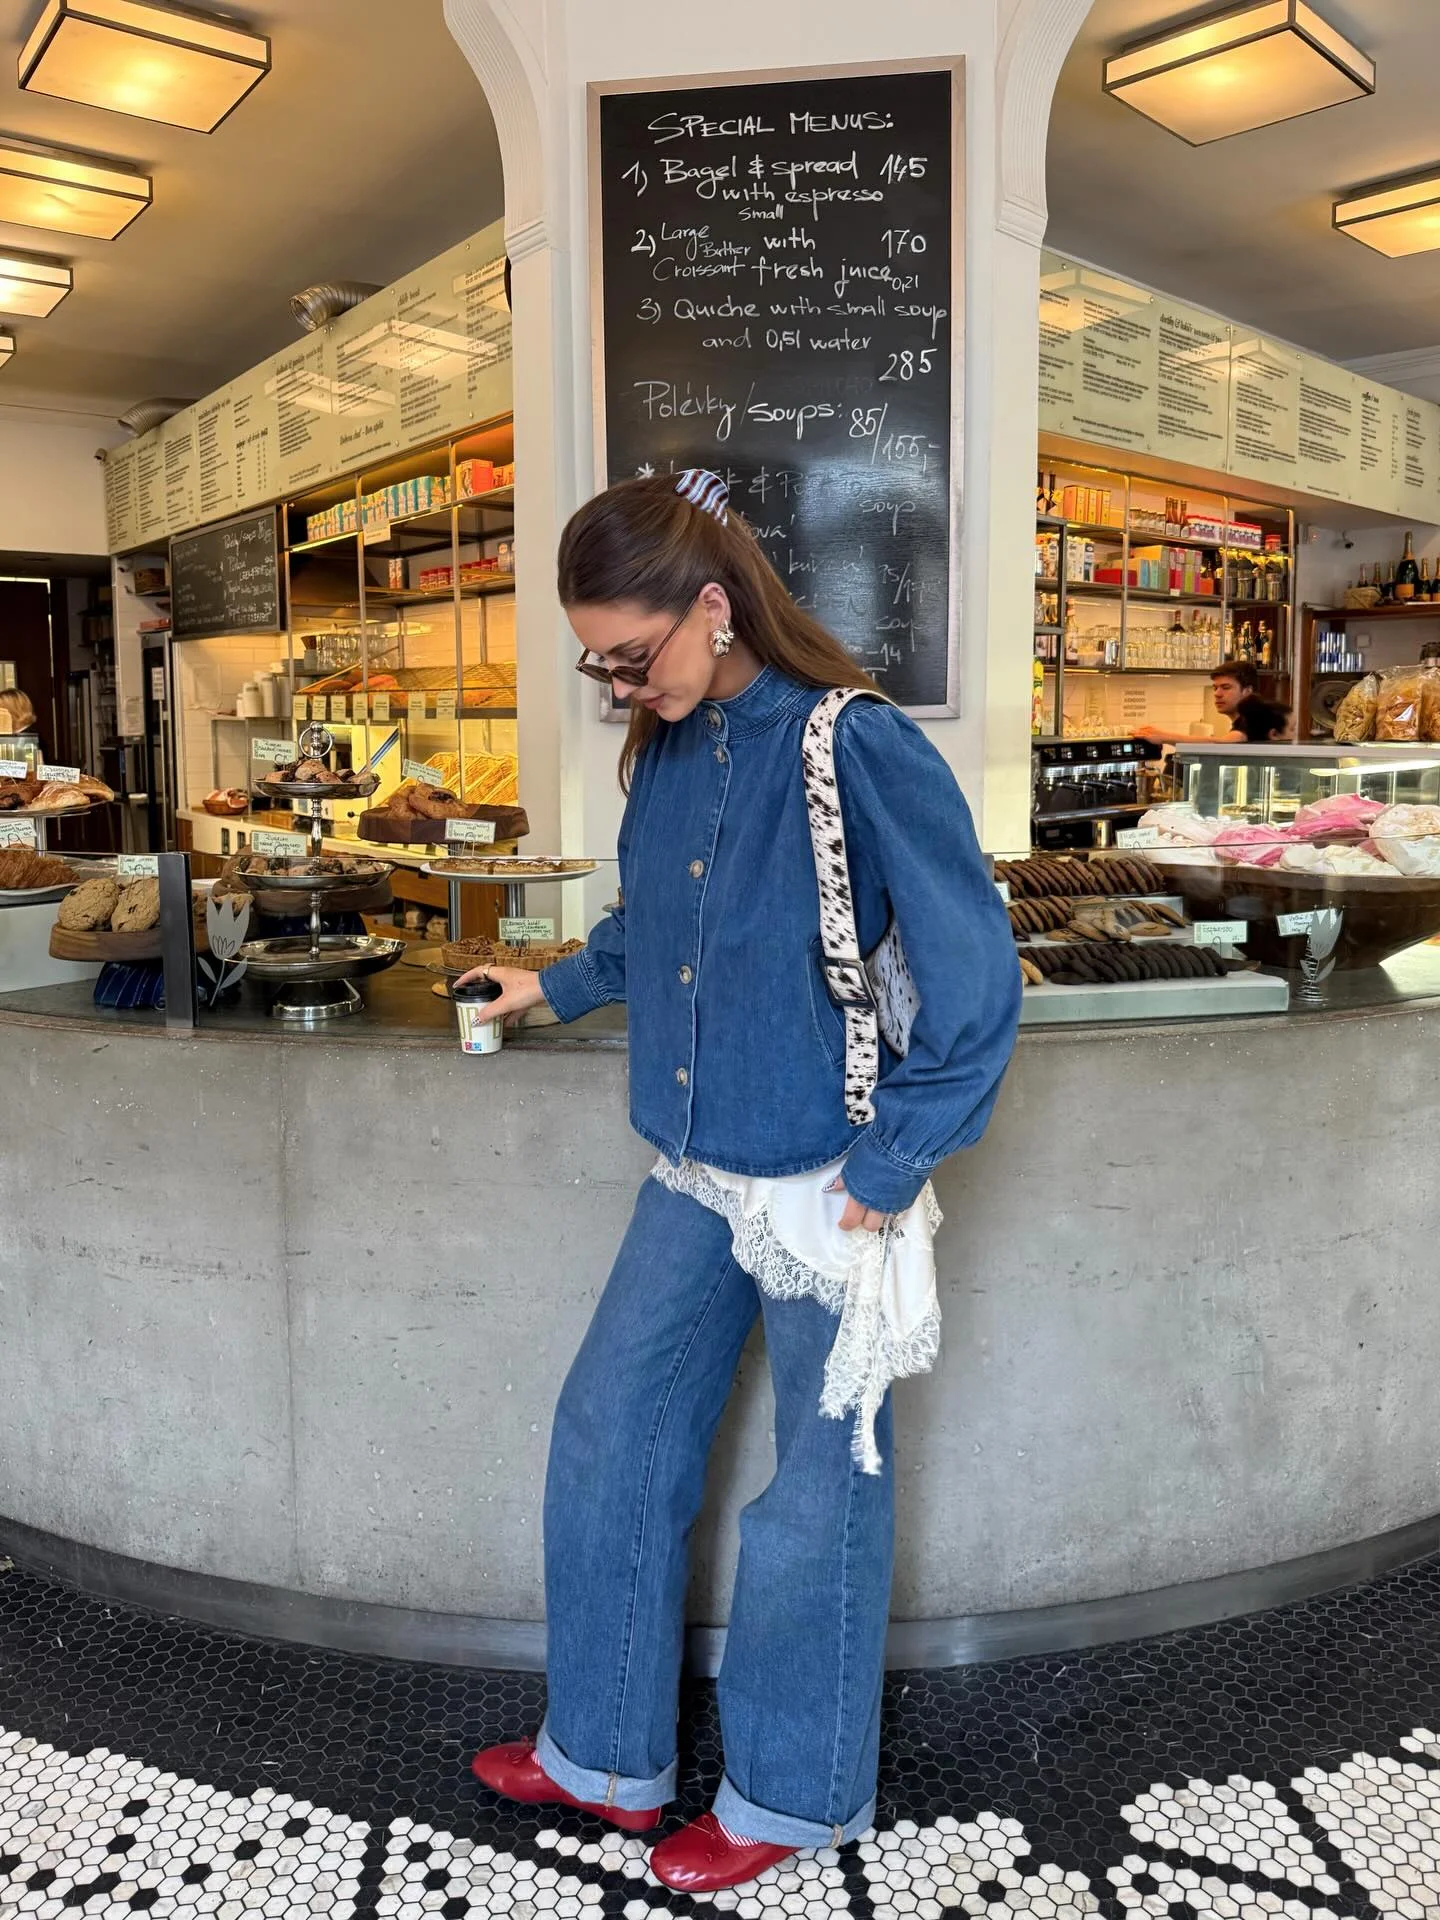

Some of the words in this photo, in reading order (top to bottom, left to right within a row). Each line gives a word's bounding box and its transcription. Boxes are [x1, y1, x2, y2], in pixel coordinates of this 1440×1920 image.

[648, 112, 775, 144] SPECIAL
[790, 111, 894, 134] MENUS:
[621, 161, 648, 197] 1)
[661, 155, 736, 199] Bagel
[748, 154, 764, 180] &
[770, 150, 859, 190] spread
[879, 153, 928, 184] 145
[721, 182, 775, 201] with
[784, 187, 884, 221] espresso
[630, 229, 656, 258] 2)
[660, 222, 710, 261] Large
[763, 227, 816, 250] with
[880, 229, 927, 258] 170
[652, 256, 746, 281] Croissant
[751, 255, 824, 286] fresh
[833, 256, 892, 299] juice
[636, 298, 662, 325] 3)
[673, 295, 761, 320] Quiche
[770, 299, 822, 318] with
[827, 295, 886, 318] small
[893, 303, 948, 340] soup
[702, 327, 752, 349] and
[809, 332, 872, 352] water
[878, 348, 938, 382] 285
[860, 499, 916, 536] soup
